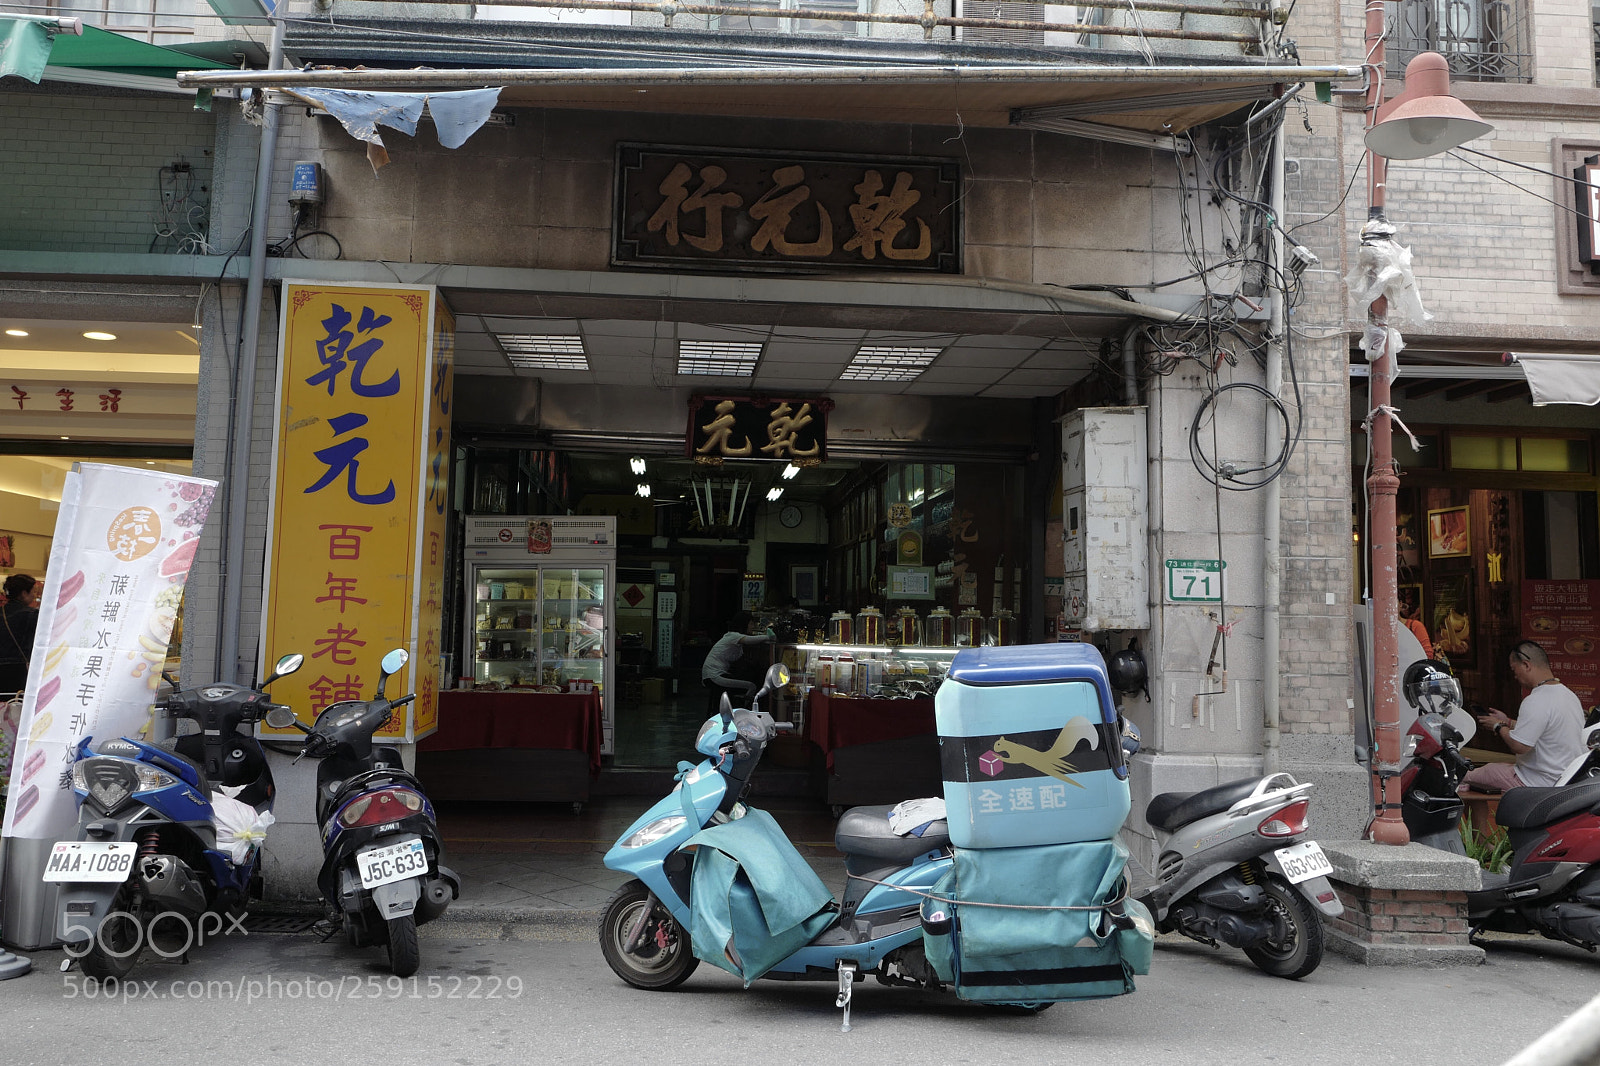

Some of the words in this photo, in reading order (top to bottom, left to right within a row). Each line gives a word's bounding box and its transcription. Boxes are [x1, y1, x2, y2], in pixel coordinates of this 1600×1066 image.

[1180, 561, 1211, 569] 迪化一段
[748, 582, 759, 595] 22
[1047, 585, 1062, 594] 71
[1183, 575, 1210, 596] 71
[977, 783, 1067, 814] 全速配
[48, 853, 131, 872] MAA-1088
[363, 850, 425, 883] J5C-633
[1282, 851, 1329, 879] 863-CYB
